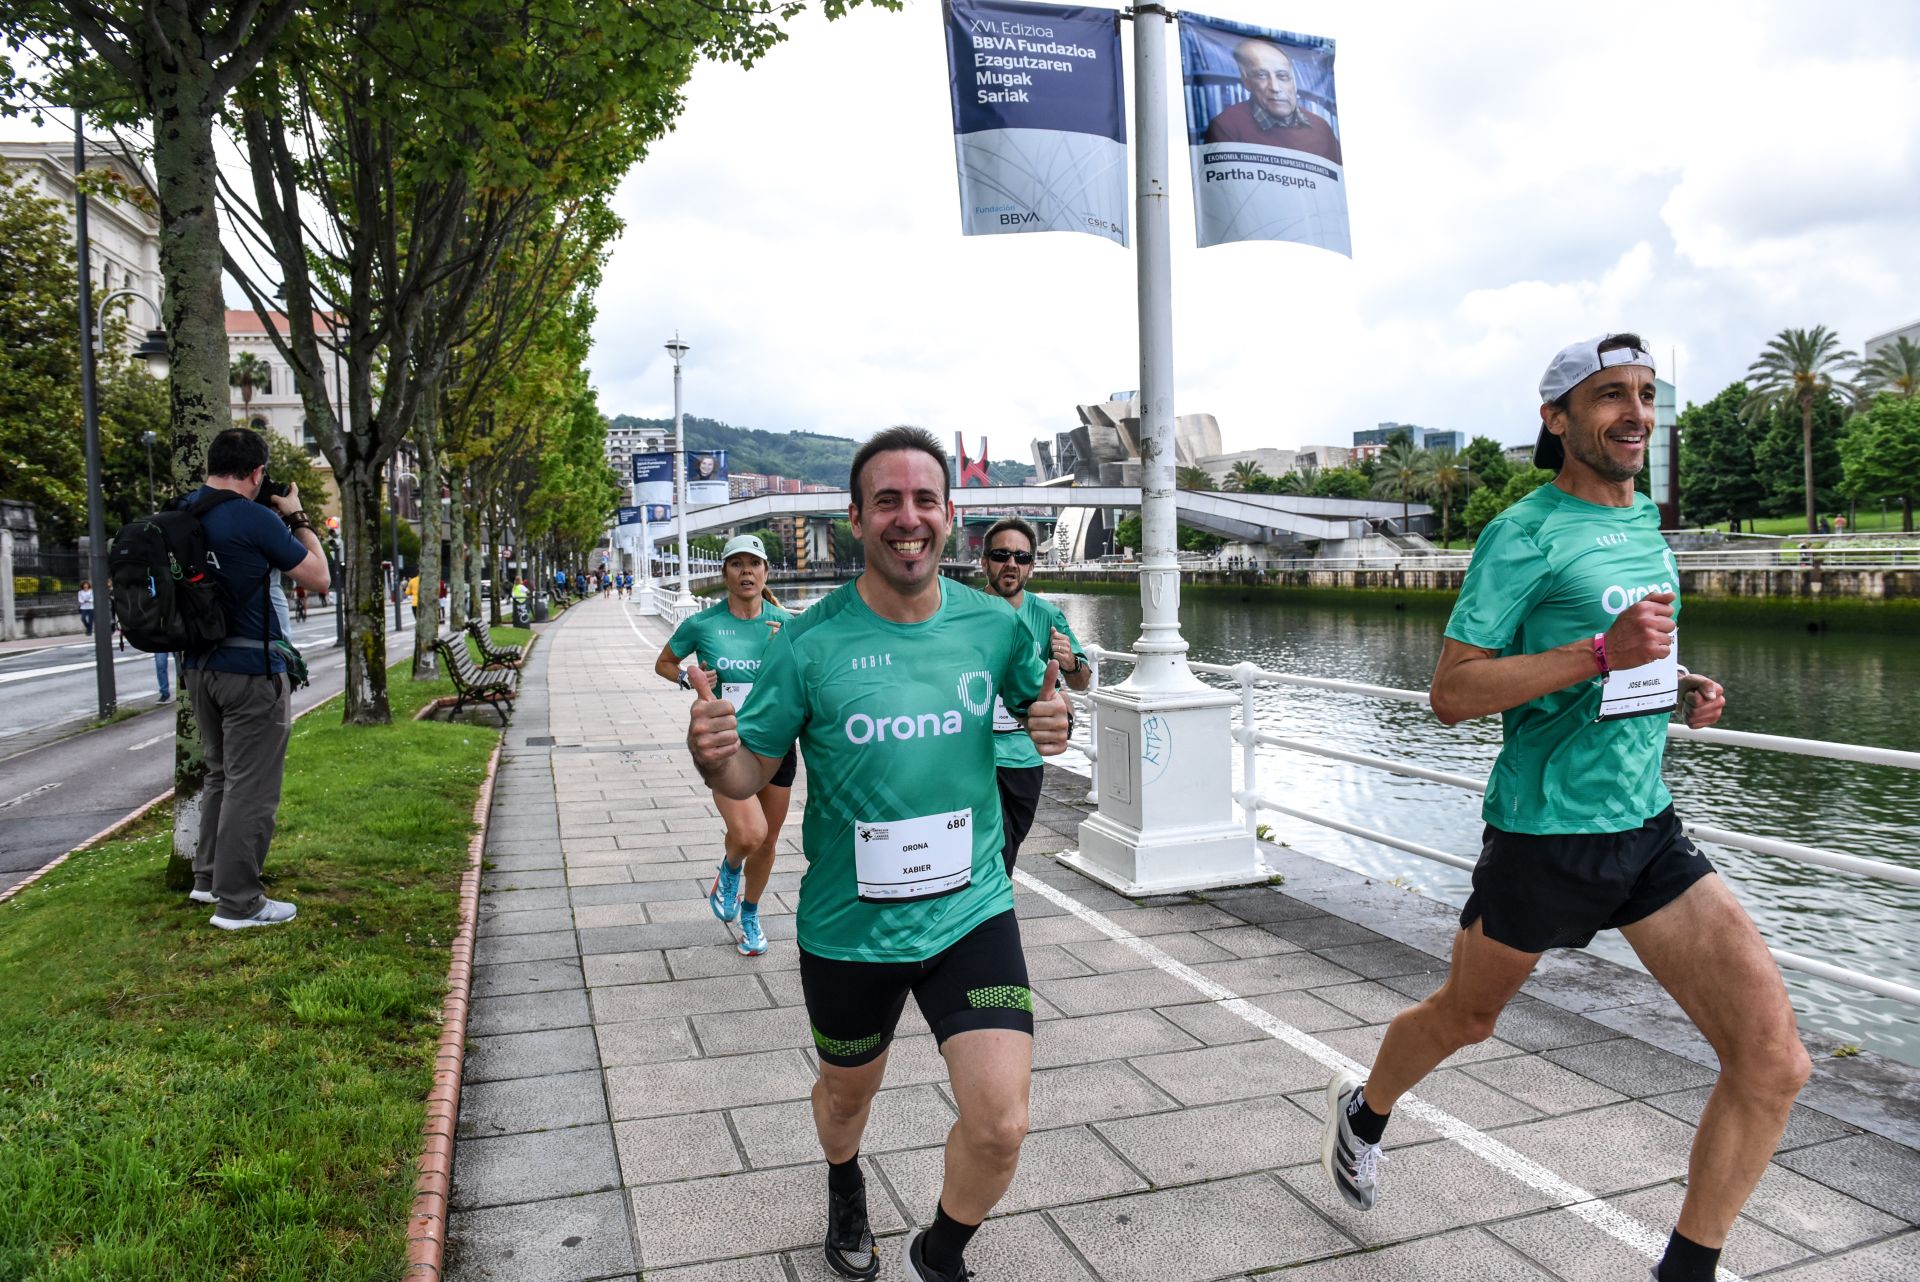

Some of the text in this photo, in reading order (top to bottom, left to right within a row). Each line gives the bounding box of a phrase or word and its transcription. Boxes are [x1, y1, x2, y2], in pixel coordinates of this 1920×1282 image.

[970, 20, 1053, 38] XVI. Edizioa
[972, 36, 1096, 58] BBVA Fundazioa
[974, 53, 1072, 72] Ezagutzaren
[976, 71, 1032, 86] Mugak
[977, 89, 1029, 104] Sariak
[1206, 169, 1316, 189] Partha Dasgupta
[975, 205, 1016, 214] Fundación
[1000, 212, 1040, 225] BBVA
[1088, 218, 1107, 227] CSIC
[852, 653, 892, 670] GOBIK
[1627, 678, 1661, 689] JOSE MIGUEL
[845, 710, 962, 745] Orona
[947, 818, 966, 830] 680
[902, 842, 929, 852] ORONA
[902, 864, 932, 875] XABIER
